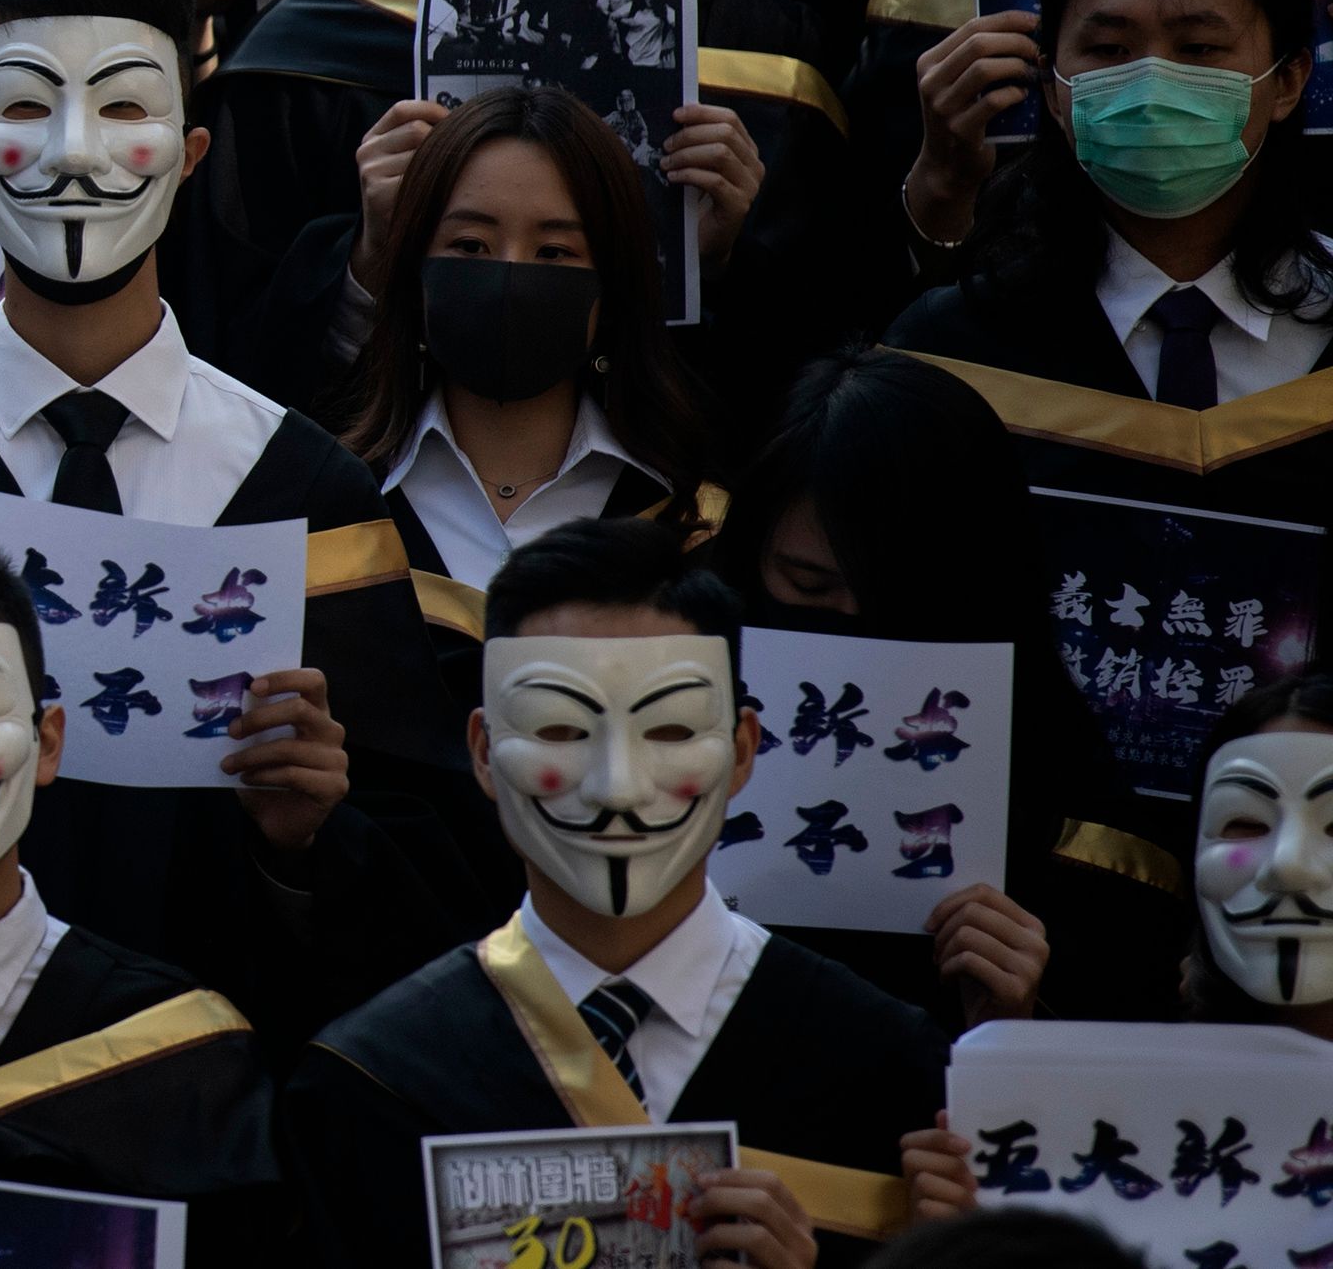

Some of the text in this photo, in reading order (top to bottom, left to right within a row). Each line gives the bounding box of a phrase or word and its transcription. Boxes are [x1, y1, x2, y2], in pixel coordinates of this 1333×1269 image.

[456, 58, 514, 70] 2019.6.12
[1049, 570, 1269, 648] 義士無罪
